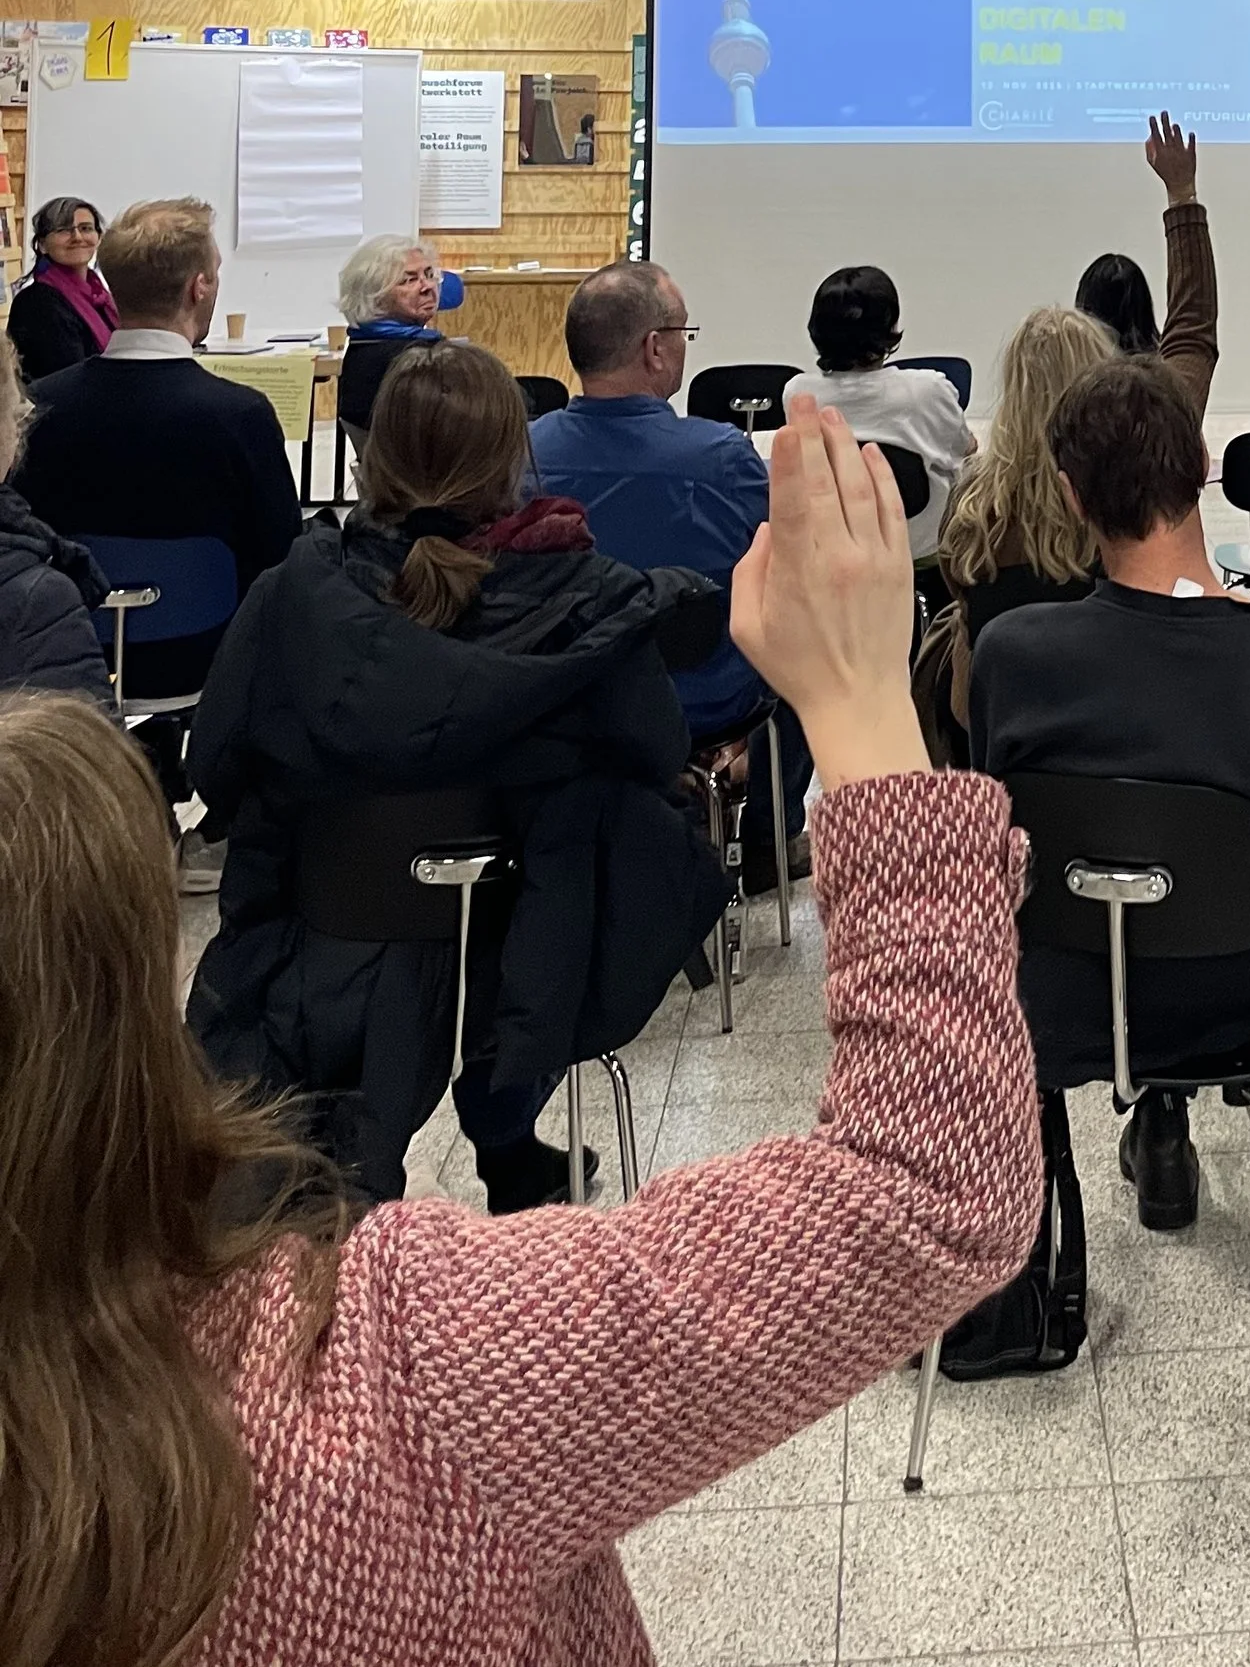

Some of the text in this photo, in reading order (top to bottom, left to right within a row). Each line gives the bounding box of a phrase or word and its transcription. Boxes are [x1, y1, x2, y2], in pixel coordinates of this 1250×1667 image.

[979, 7, 1126, 31] DIGITALEN
[97, 21, 115, 75] 1
[979, 41, 1063, 65] RAUM
[1188, 82, 1230, 91] BERLIN
[420, 142, 488, 152] Beteiligung
